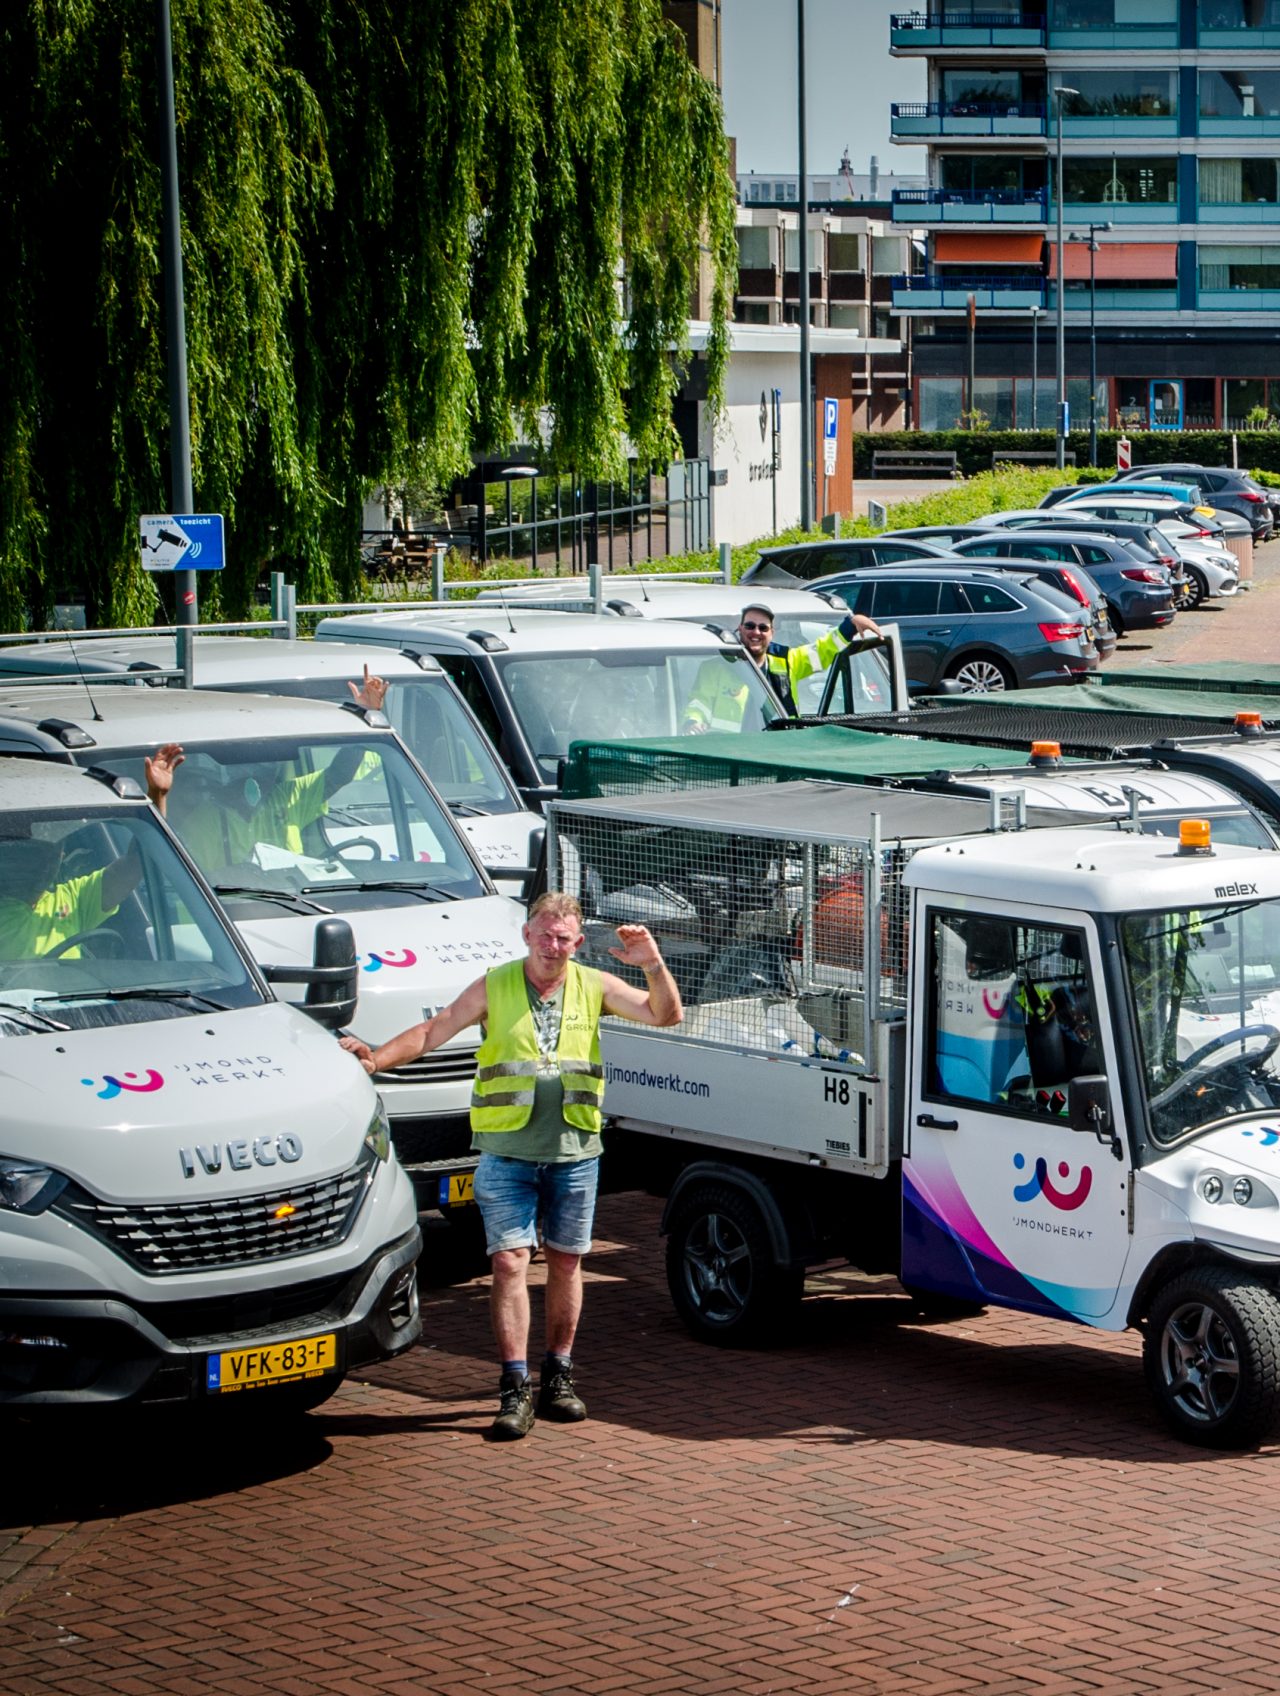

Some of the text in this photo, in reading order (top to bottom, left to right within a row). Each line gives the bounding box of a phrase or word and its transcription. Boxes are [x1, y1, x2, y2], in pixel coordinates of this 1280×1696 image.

[826, 403, 836, 435] P
[1214, 882, 1259, 898] melex
[438, 950, 514, 964] WERKT
[191, 1067, 287, 1086] WERKT
[824, 1076, 850, 1105] H8
[825, 1139, 850, 1151] TIEBIES
[178, 1132, 304, 1179] IVECO
[230, 1340, 327, 1379] VFK-83-F
[209, 1373, 218, 1382] NL
